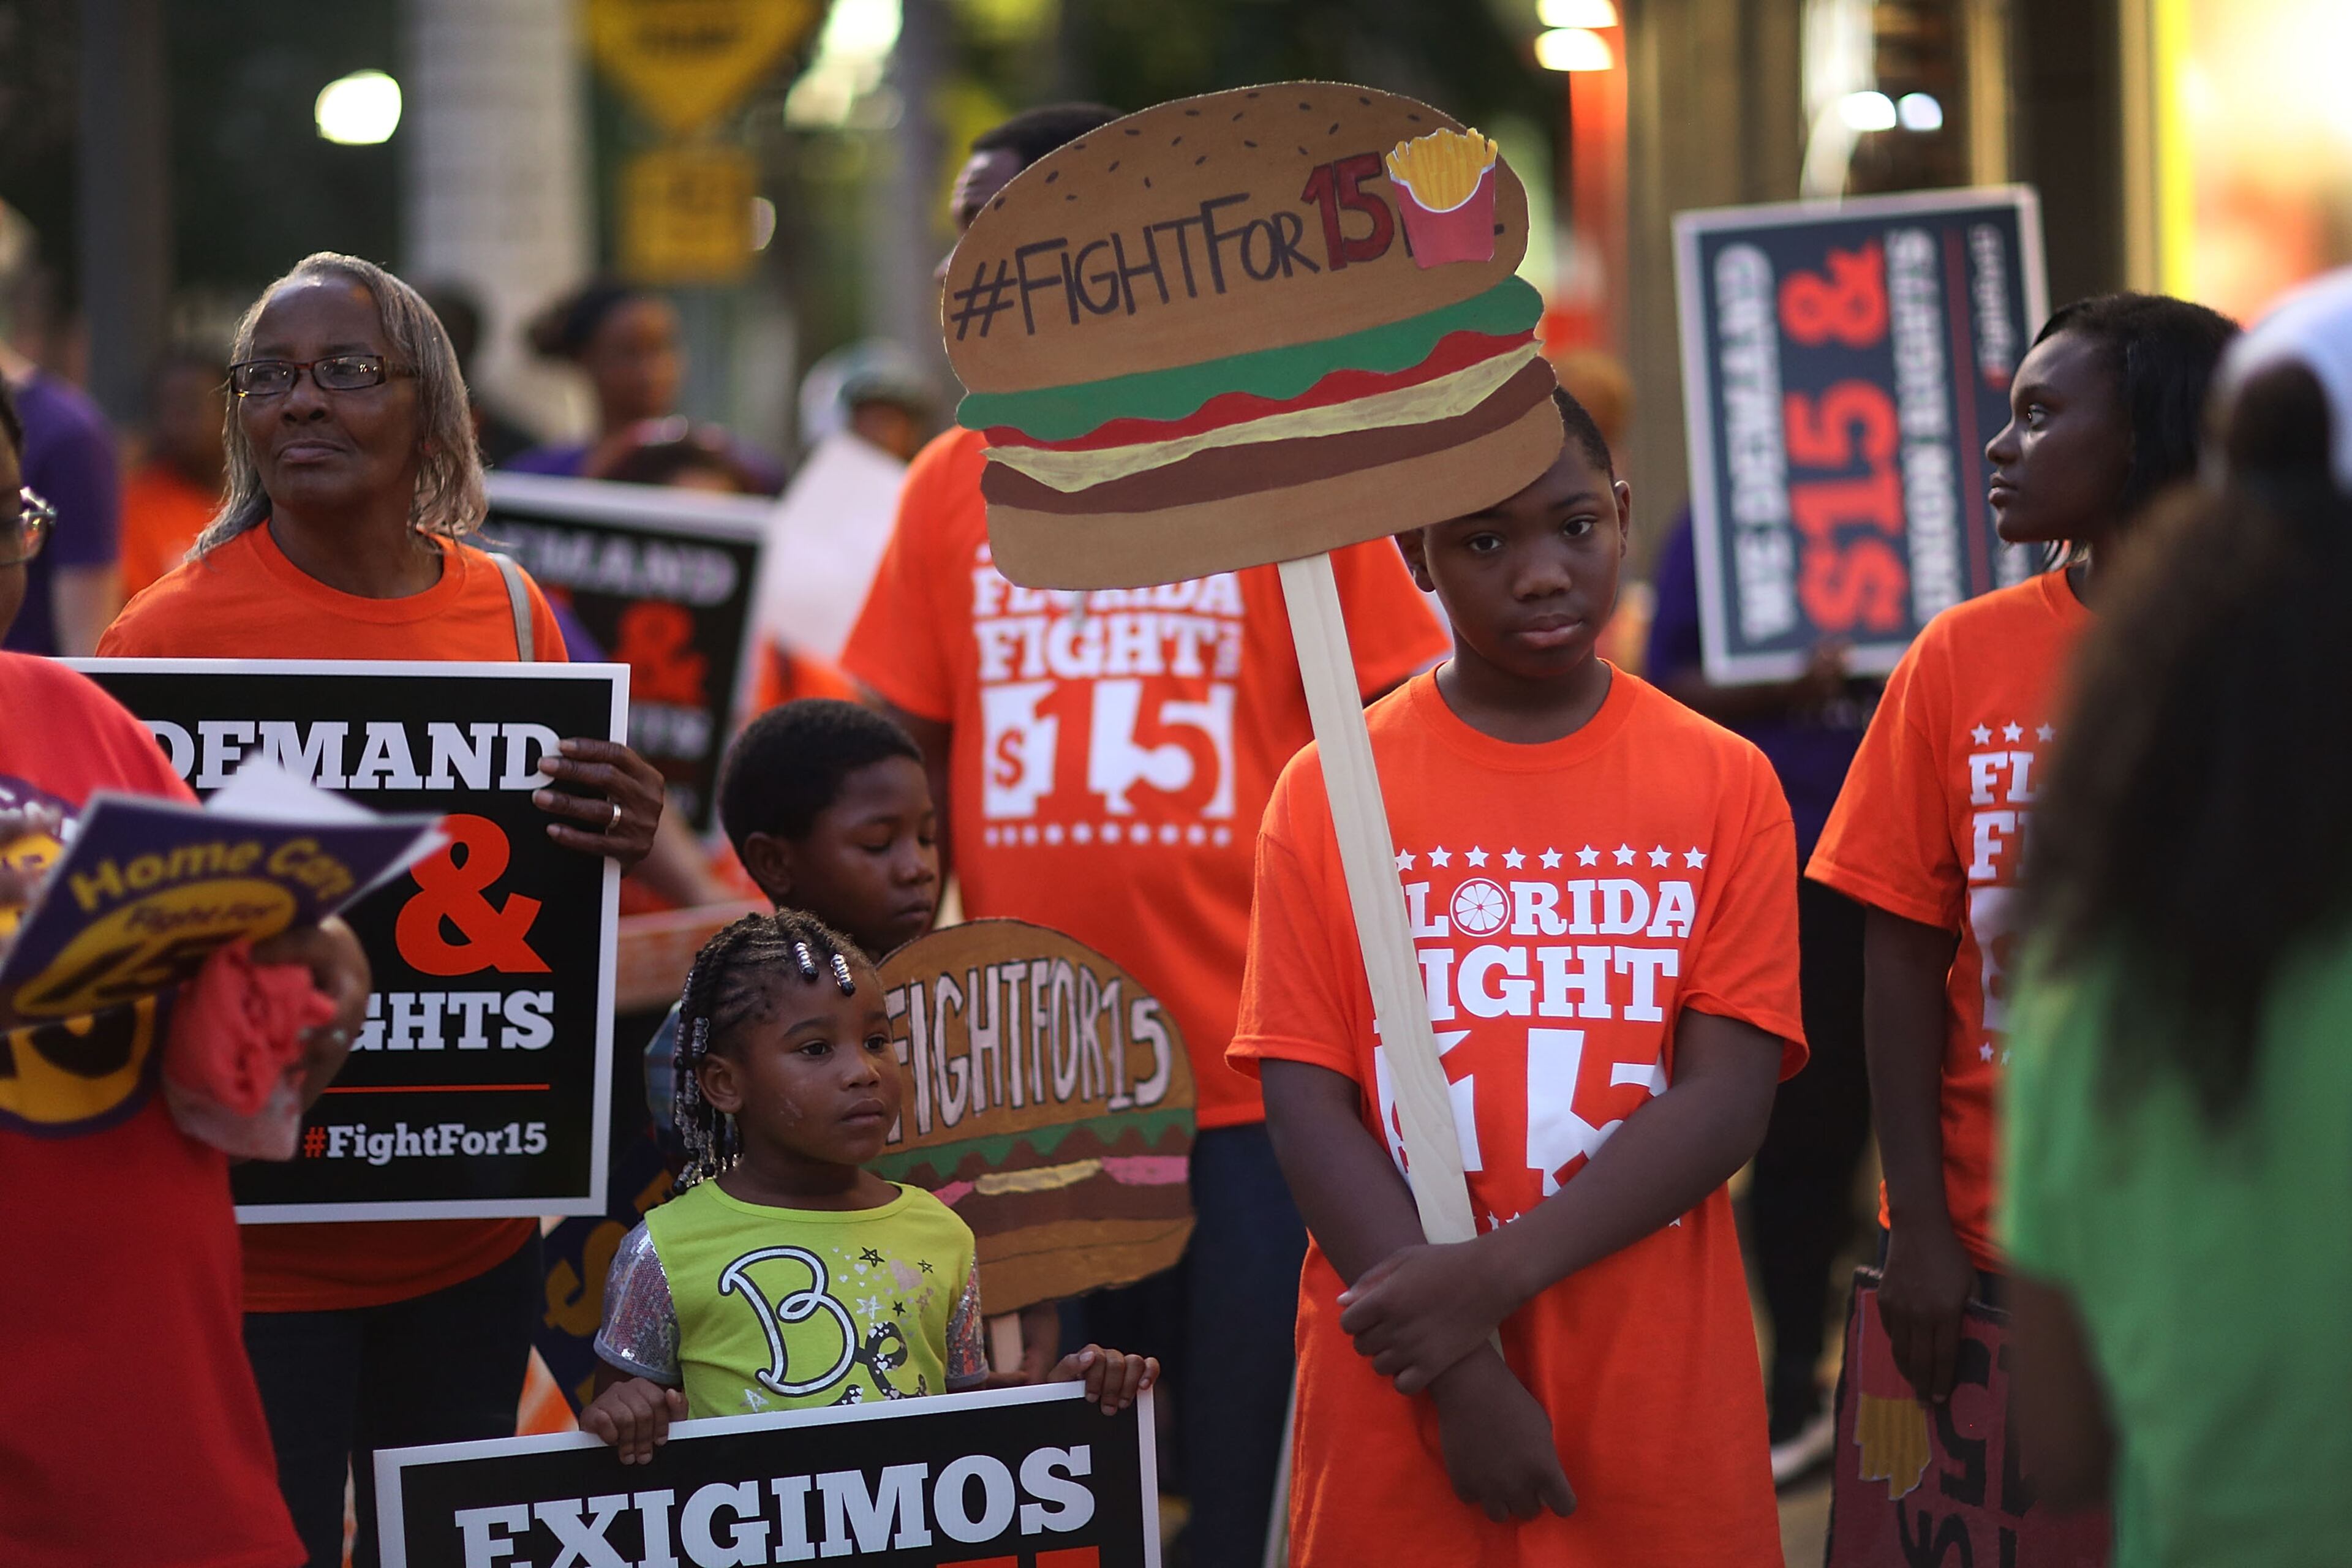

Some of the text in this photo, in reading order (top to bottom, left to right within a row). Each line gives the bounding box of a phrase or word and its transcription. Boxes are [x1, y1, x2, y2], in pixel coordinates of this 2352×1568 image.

[1779, 238, 1907, 632] $15 &
[974, 614, 1216, 681] FIGHT
[992, 679, 1221, 818] $15
[69, 840, 263, 912] Home
[395, 813, 552, 976] &
[1401, 877, 1695, 938] LORIDA
[350, 990, 554, 1050] GHTS
[1418, 944, 1678, 1022] IGHT
[304, 1122, 548, 1165] #FightFor15
[718, 1245, 927, 1401] Be
[454, 1444, 1095, 1568] EXIGIMOS
